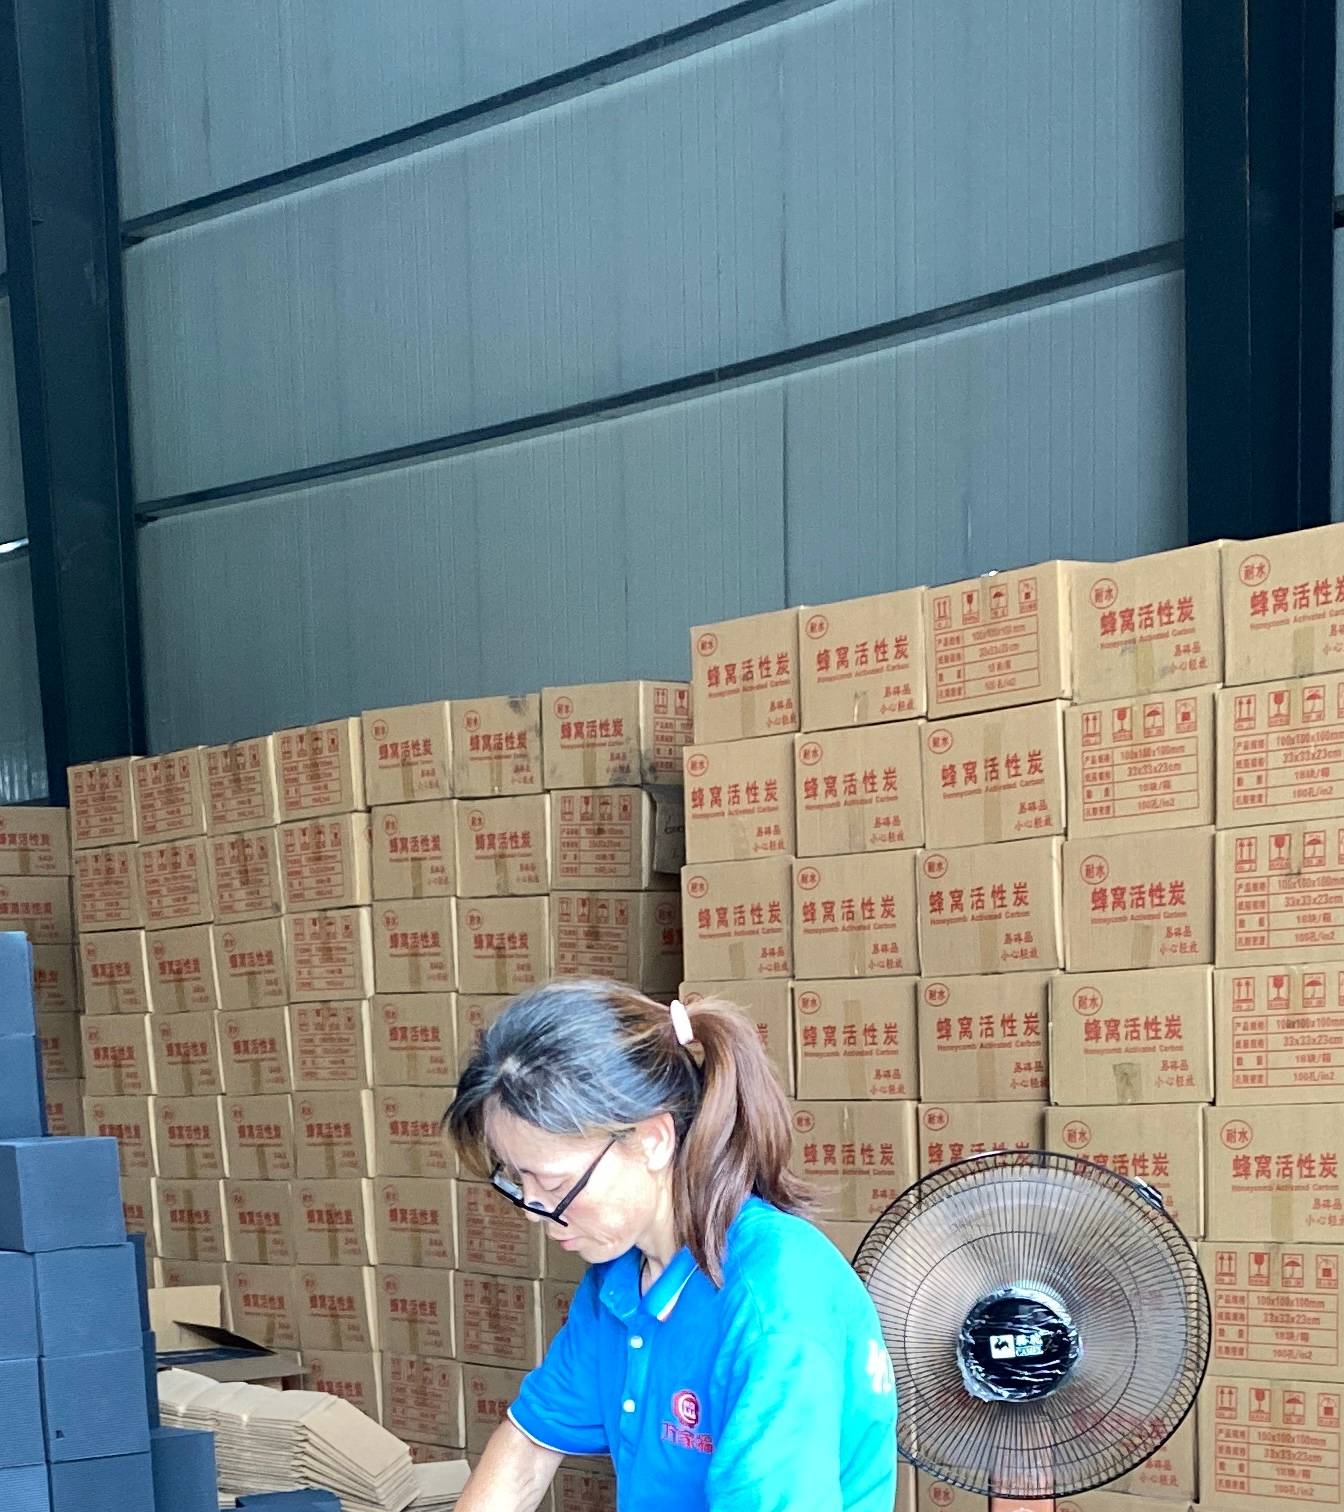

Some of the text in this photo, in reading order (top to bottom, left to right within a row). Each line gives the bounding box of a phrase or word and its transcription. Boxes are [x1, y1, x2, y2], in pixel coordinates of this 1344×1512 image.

[1099, 598, 1194, 639] 蜂窝活性炭
[816, 636, 910, 673] 蜂窝活性炭
